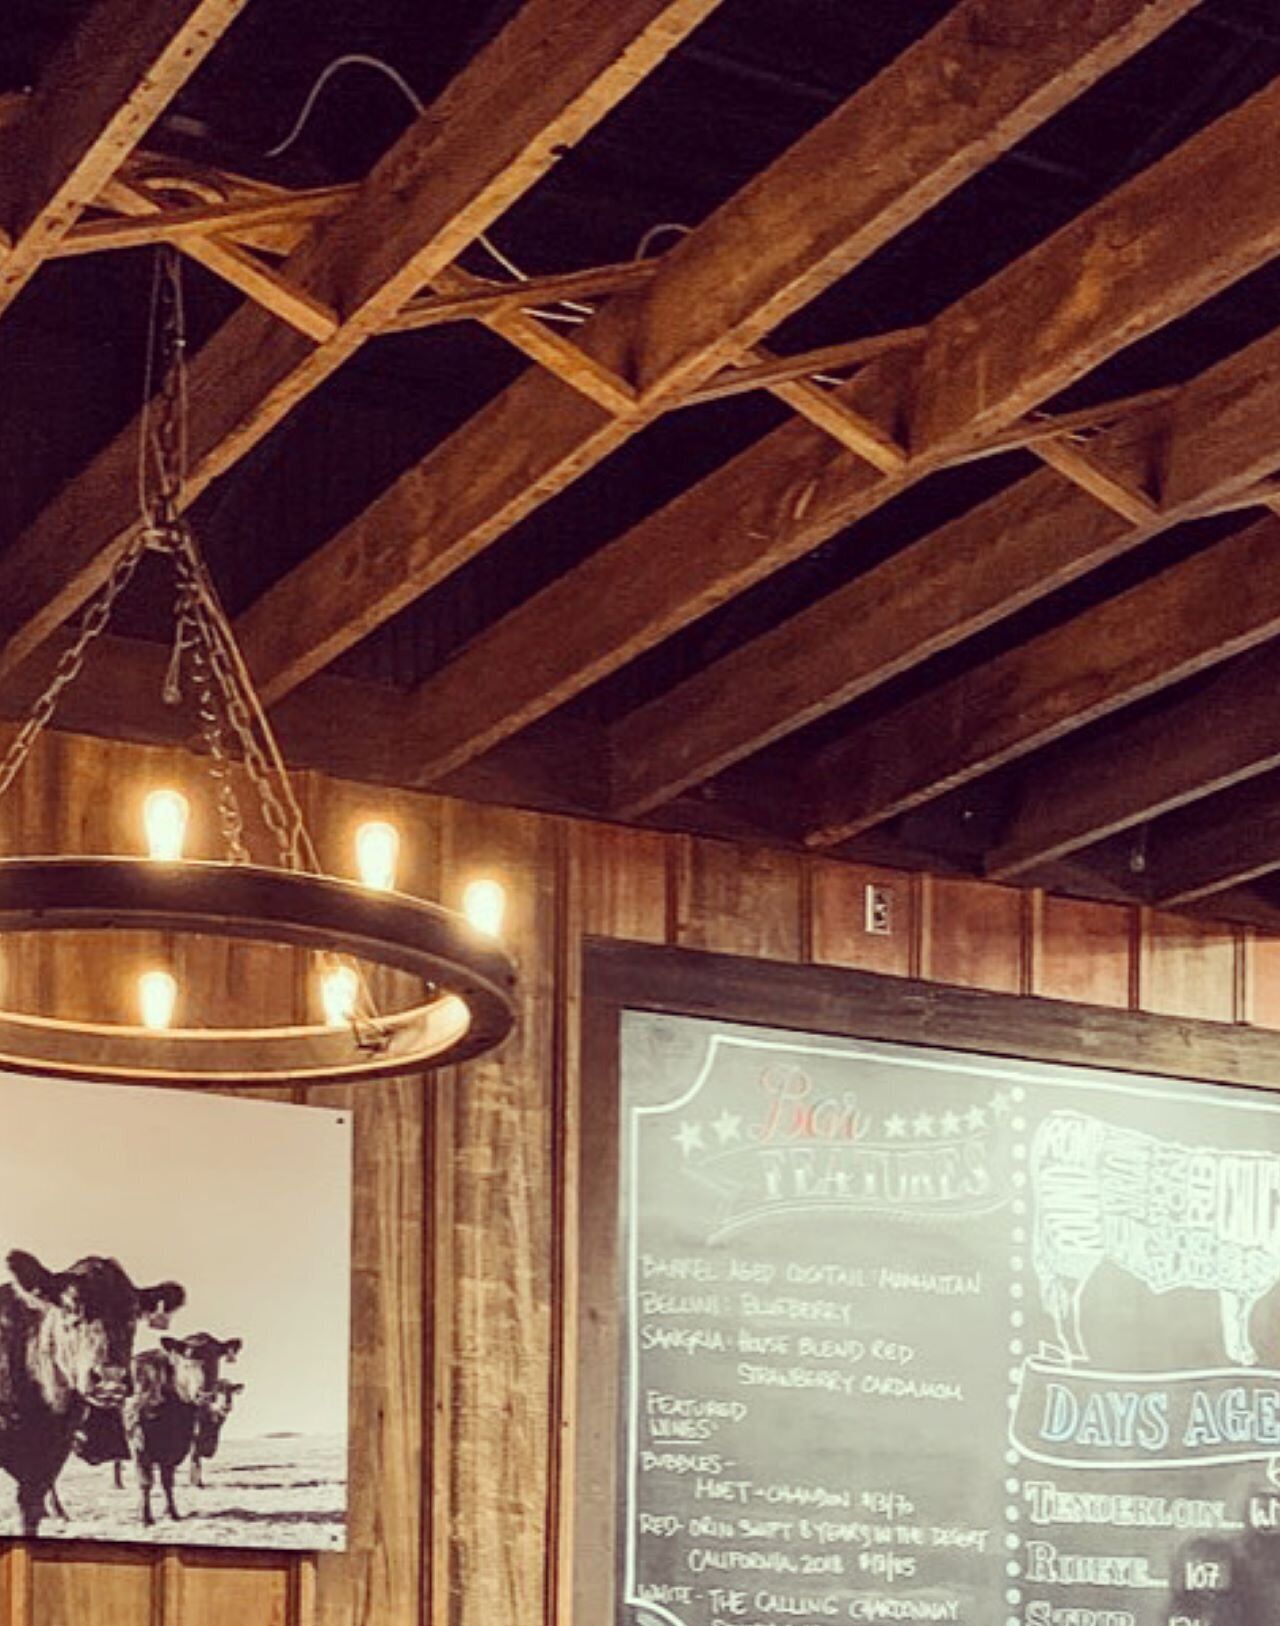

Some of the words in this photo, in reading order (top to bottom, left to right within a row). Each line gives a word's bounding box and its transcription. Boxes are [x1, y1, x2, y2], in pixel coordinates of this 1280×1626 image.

[797, 1336, 865, 1362] BLEND
[871, 1339, 914, 1366] RED
[1039, 1383, 1169, 1450] DAYS
[708, 1588, 747, 1616] THE
[754, 1591, 839, 1616] CALLING
